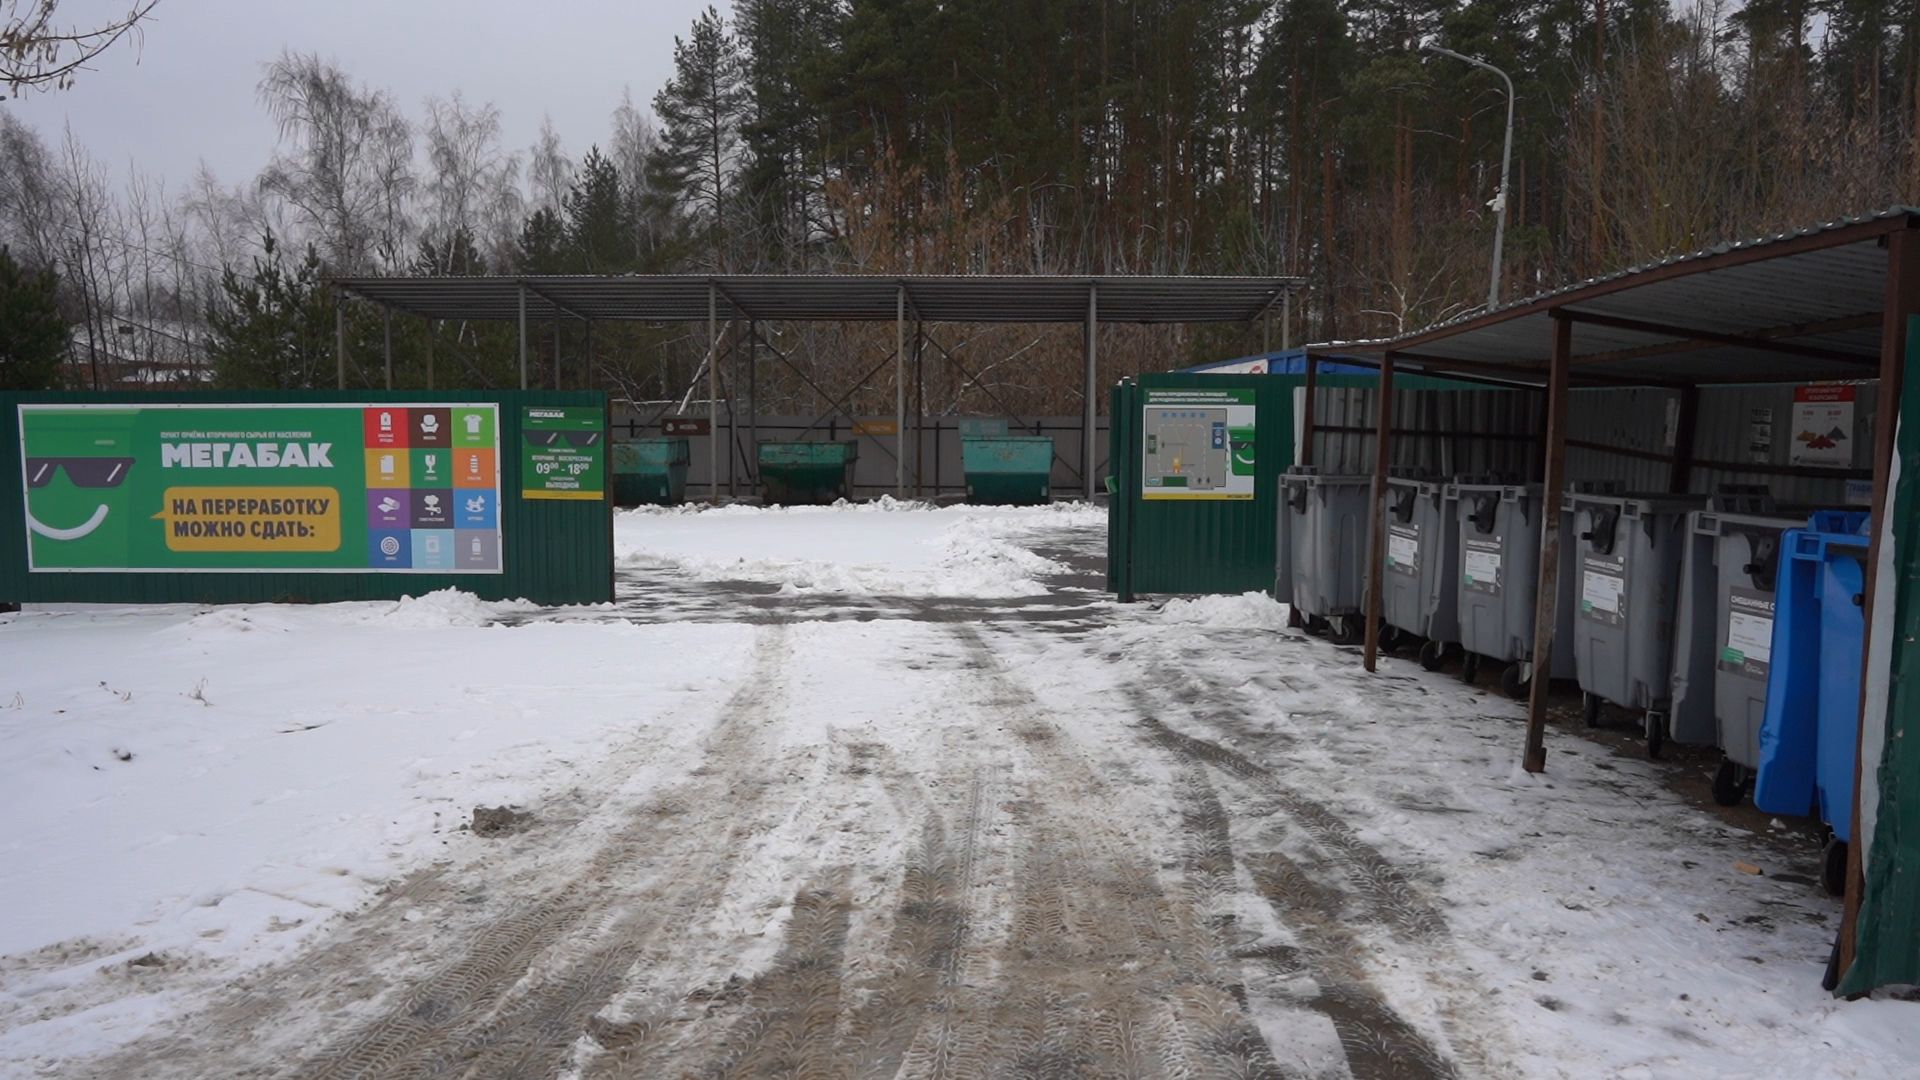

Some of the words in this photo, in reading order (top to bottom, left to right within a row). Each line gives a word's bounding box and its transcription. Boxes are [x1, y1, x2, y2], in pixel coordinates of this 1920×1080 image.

[161, 442, 334, 468] МЕГАБАК
[172, 498, 197, 515] НА
[202, 498, 330, 516] ПЕРЕРАБОТКУ
[174, 521, 246, 537] МОЖНО
[250, 521, 315, 539] СДАТЬ:
